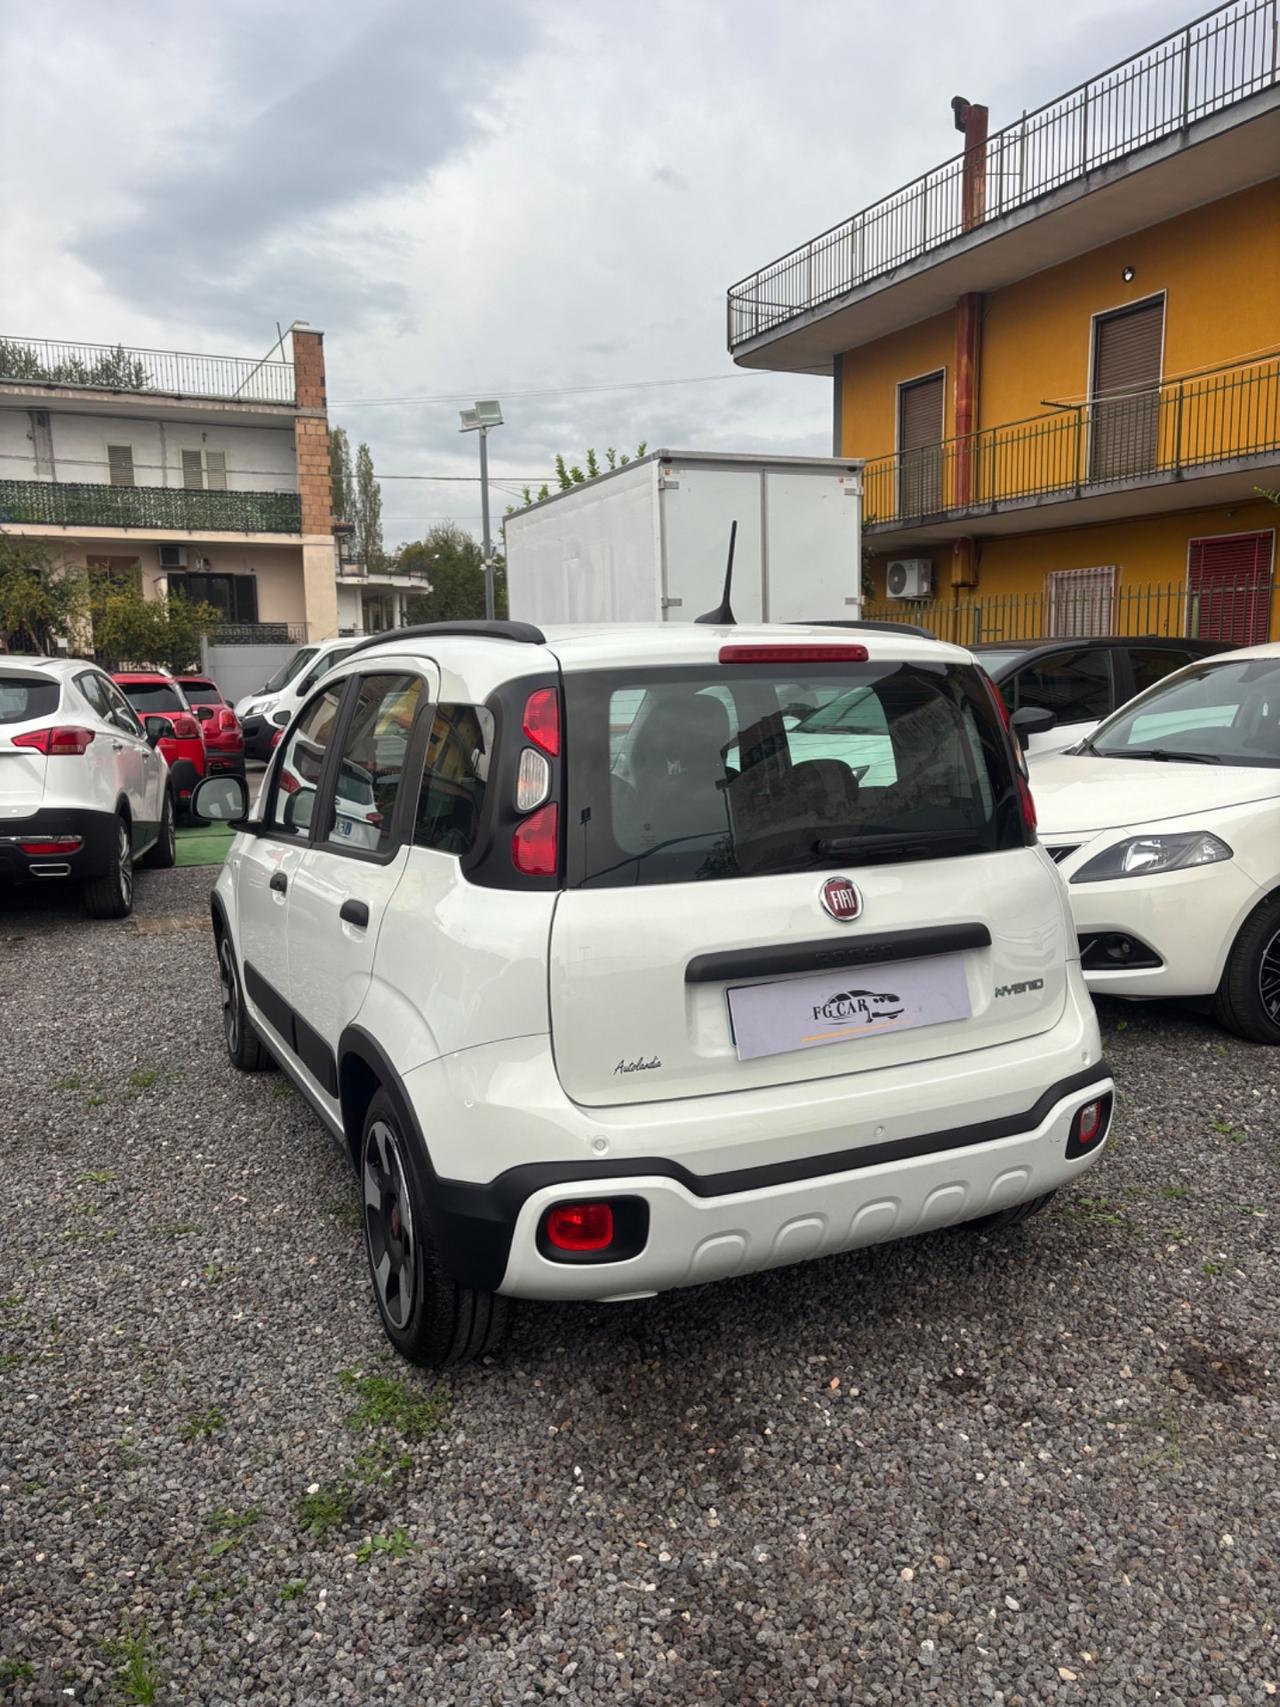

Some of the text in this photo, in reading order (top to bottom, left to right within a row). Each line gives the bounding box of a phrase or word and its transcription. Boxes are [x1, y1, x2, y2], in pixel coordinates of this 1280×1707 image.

[830, 889, 856, 909] FIAT
[812, 998, 869, 1020] FG CAR
